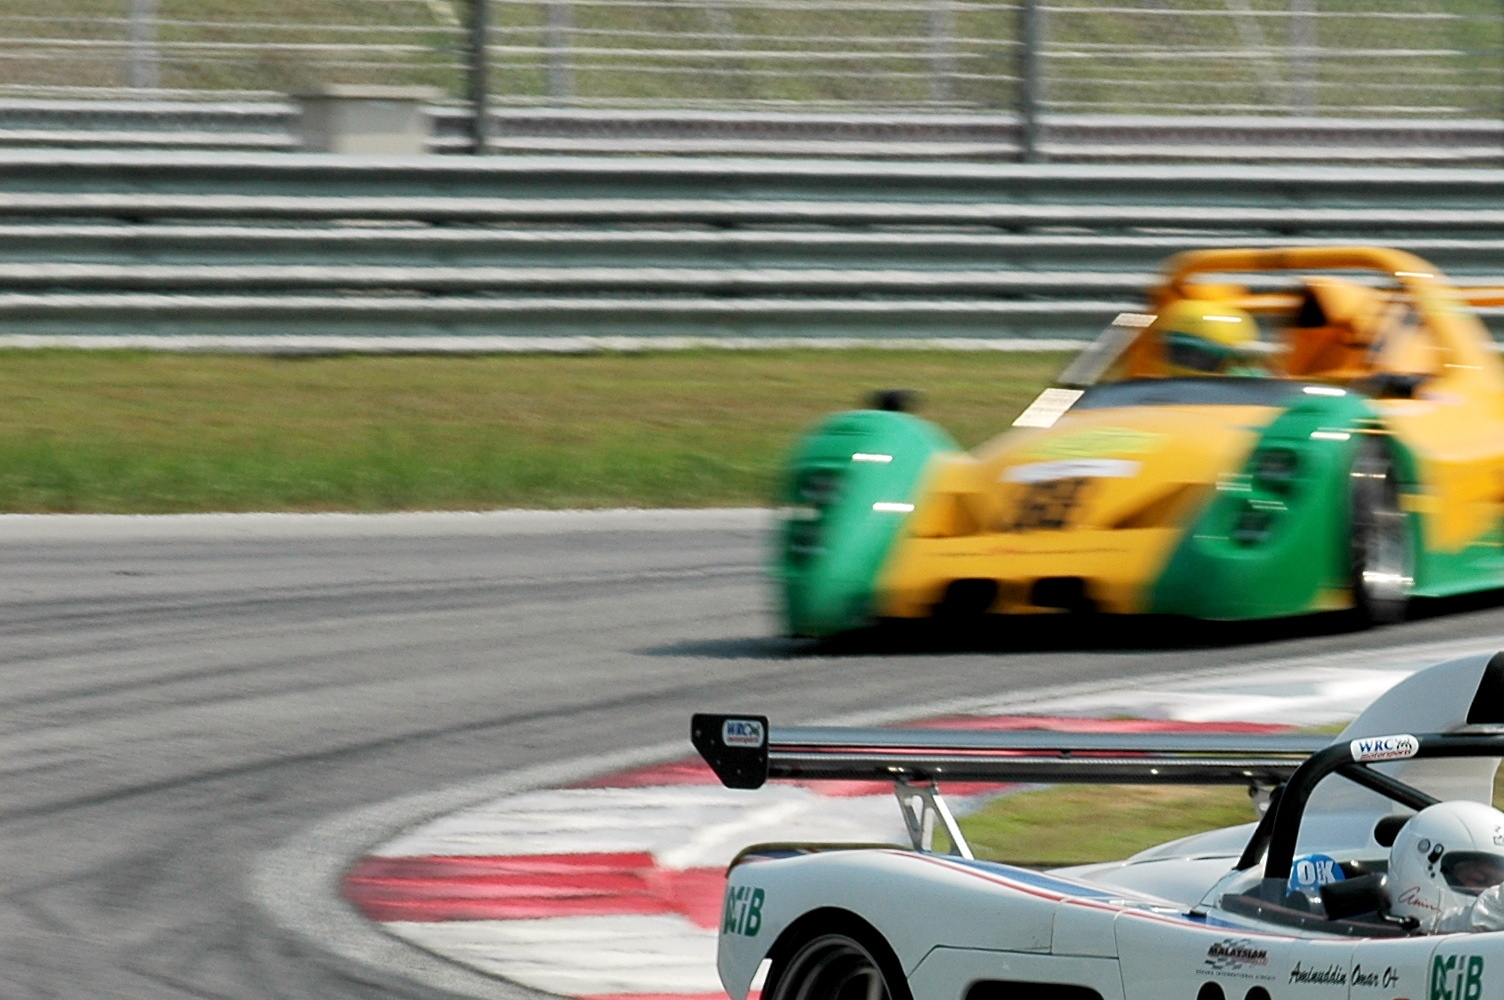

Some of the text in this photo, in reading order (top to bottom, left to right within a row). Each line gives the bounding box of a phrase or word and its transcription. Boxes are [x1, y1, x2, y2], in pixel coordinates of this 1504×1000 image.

[1359, 739, 1393, 753] WRC
[1296, 860, 1336, 885] OK
[1207, 944, 1268, 959] MALAYSIAN
